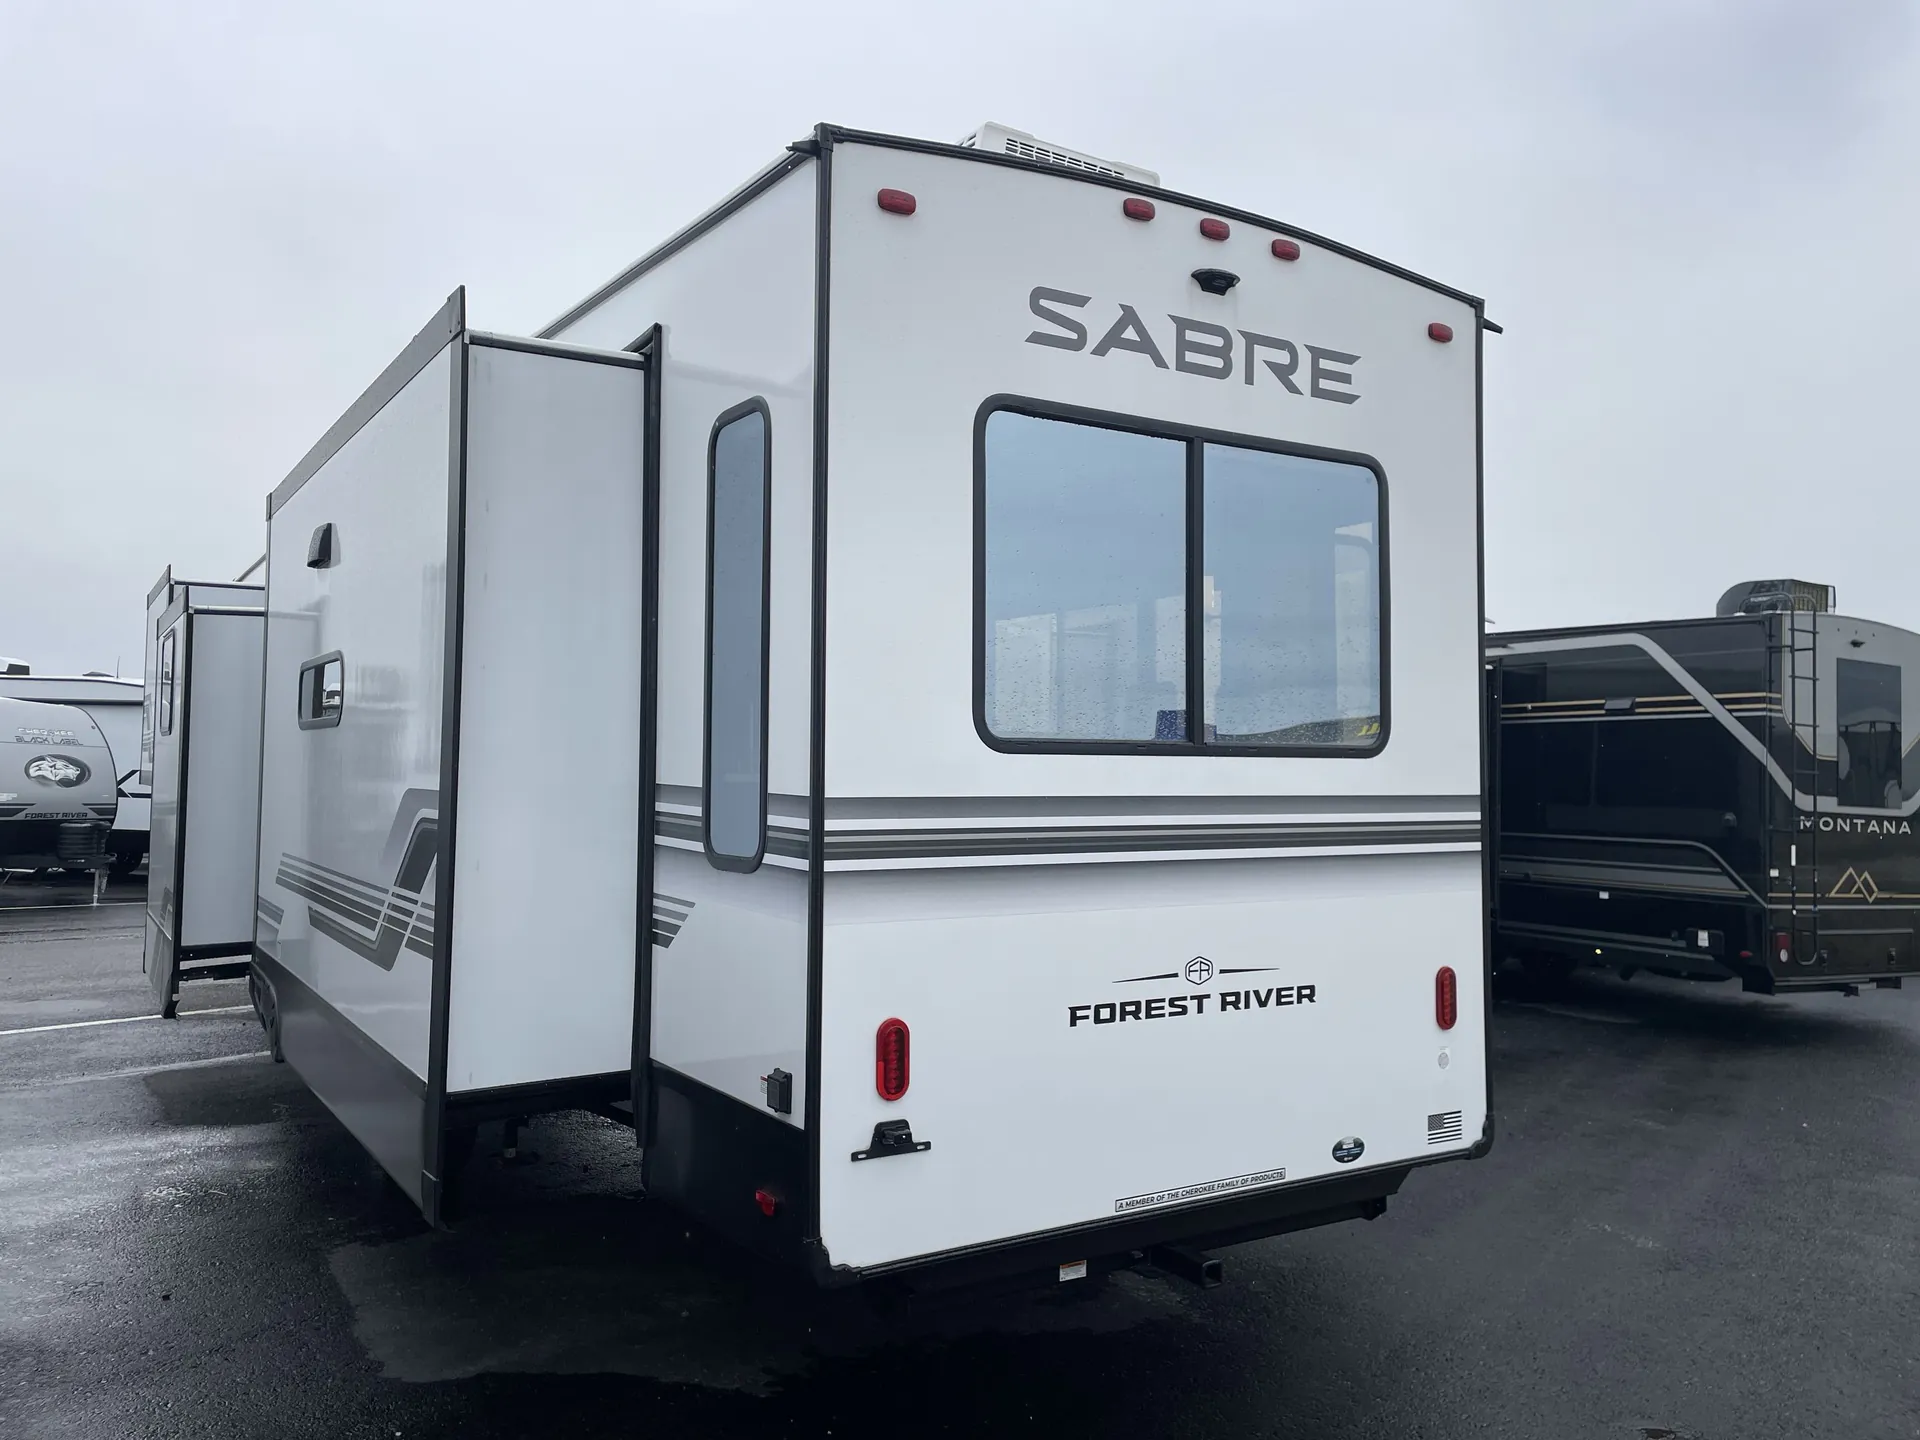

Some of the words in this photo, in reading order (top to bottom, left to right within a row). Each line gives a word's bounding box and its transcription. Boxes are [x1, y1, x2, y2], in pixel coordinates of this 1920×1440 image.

[1024, 286, 1362, 405] SABRE
[14, 736, 50, 744] BLACK
[51, 738, 84, 746] LABEL
[1800, 816, 1911, 834] MONTANA
[1068, 993, 1211, 1027] FOREST
[1219, 984, 1316, 1012] RIVER
[1125, 1196, 1155, 1208] MEMBER
[1156, 1194, 1166, 1202] OF
[1167, 1191, 1180, 1199] THE
[1181, 1184, 1217, 1196] CHEROKEE
[1217, 1179, 1240, 1190] FAMILY
[1240, 1177, 1249, 1185] OF
[1250, 1171, 1284, 1183] PRODUCTS
